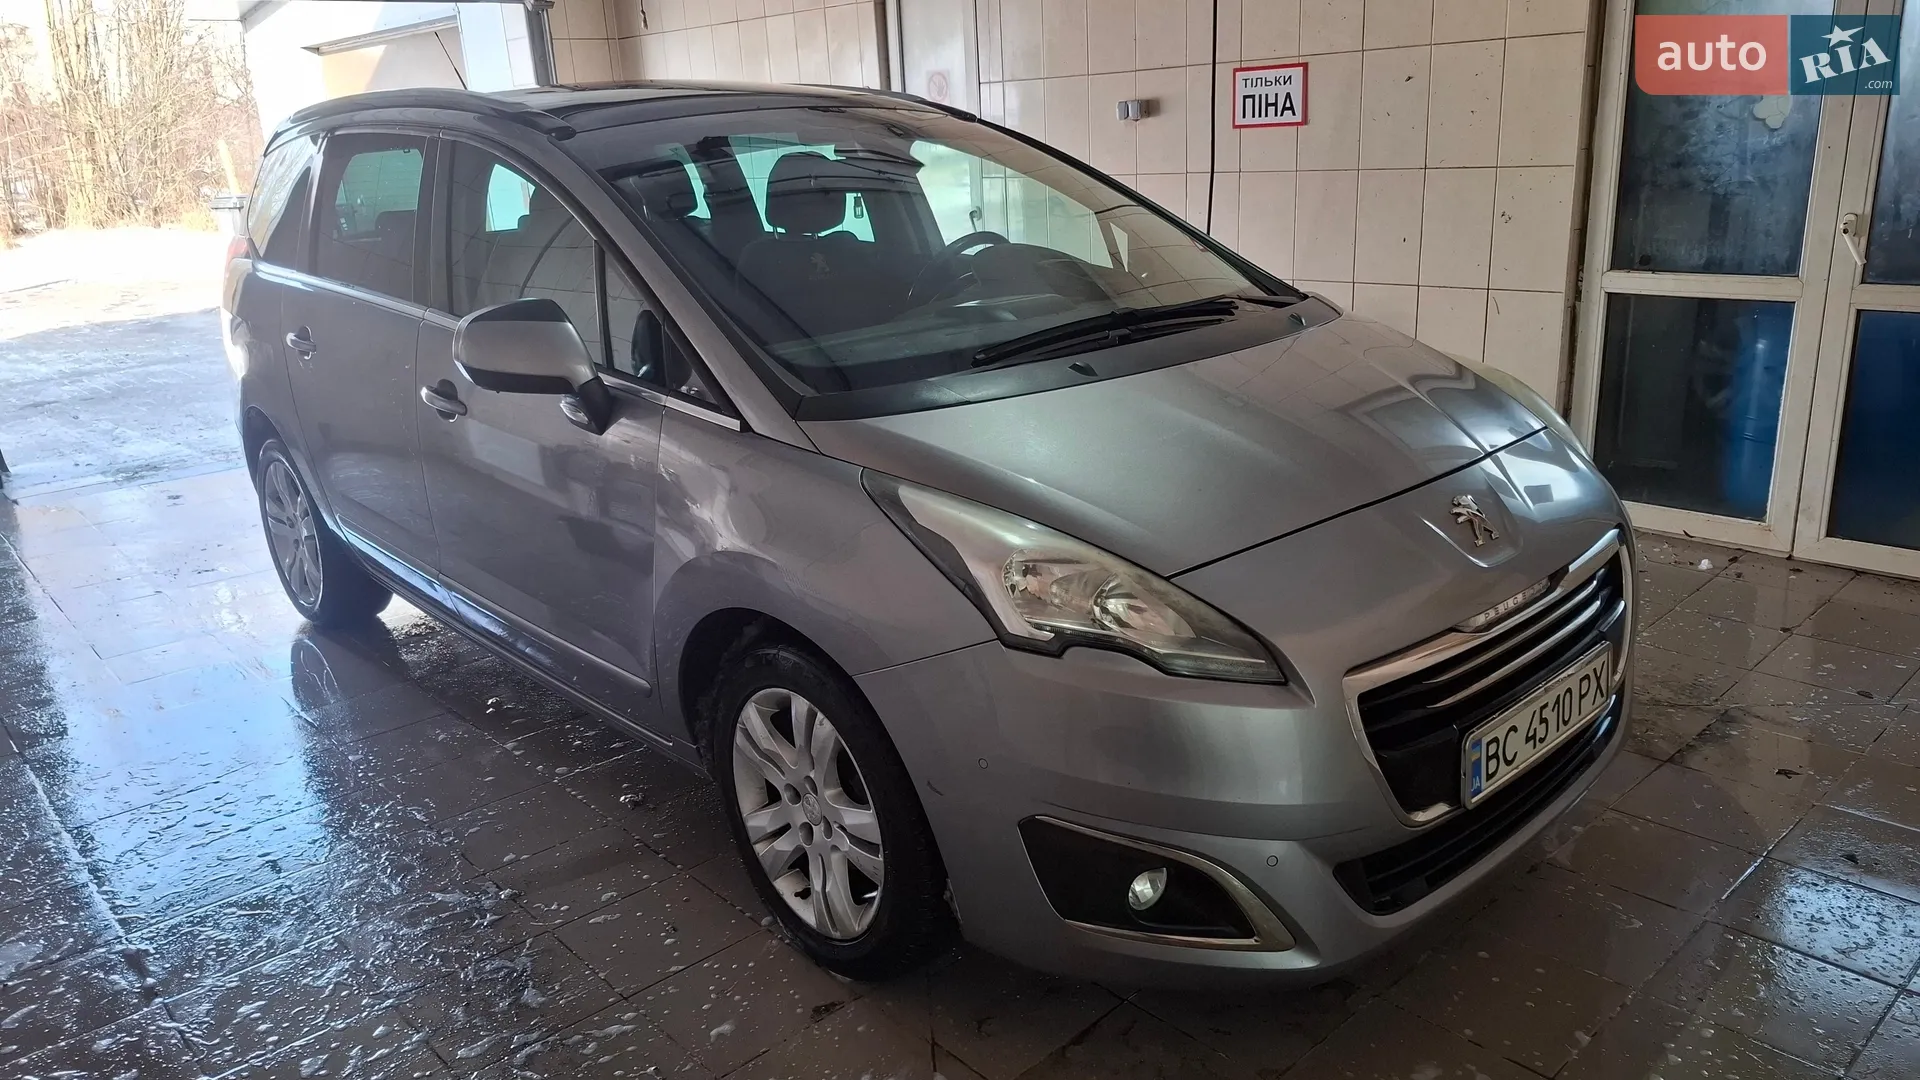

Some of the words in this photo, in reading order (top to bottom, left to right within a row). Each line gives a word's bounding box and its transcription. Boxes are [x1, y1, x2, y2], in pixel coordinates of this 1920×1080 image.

[1242, 75, 1292, 88] ТІЛЬКИ
[1242, 91, 1297, 119] ПІНА
[1485, 725, 1518, 783] BC
[1525, 686, 1573, 750] 4510
[1578, 660, 1606, 716] PX
